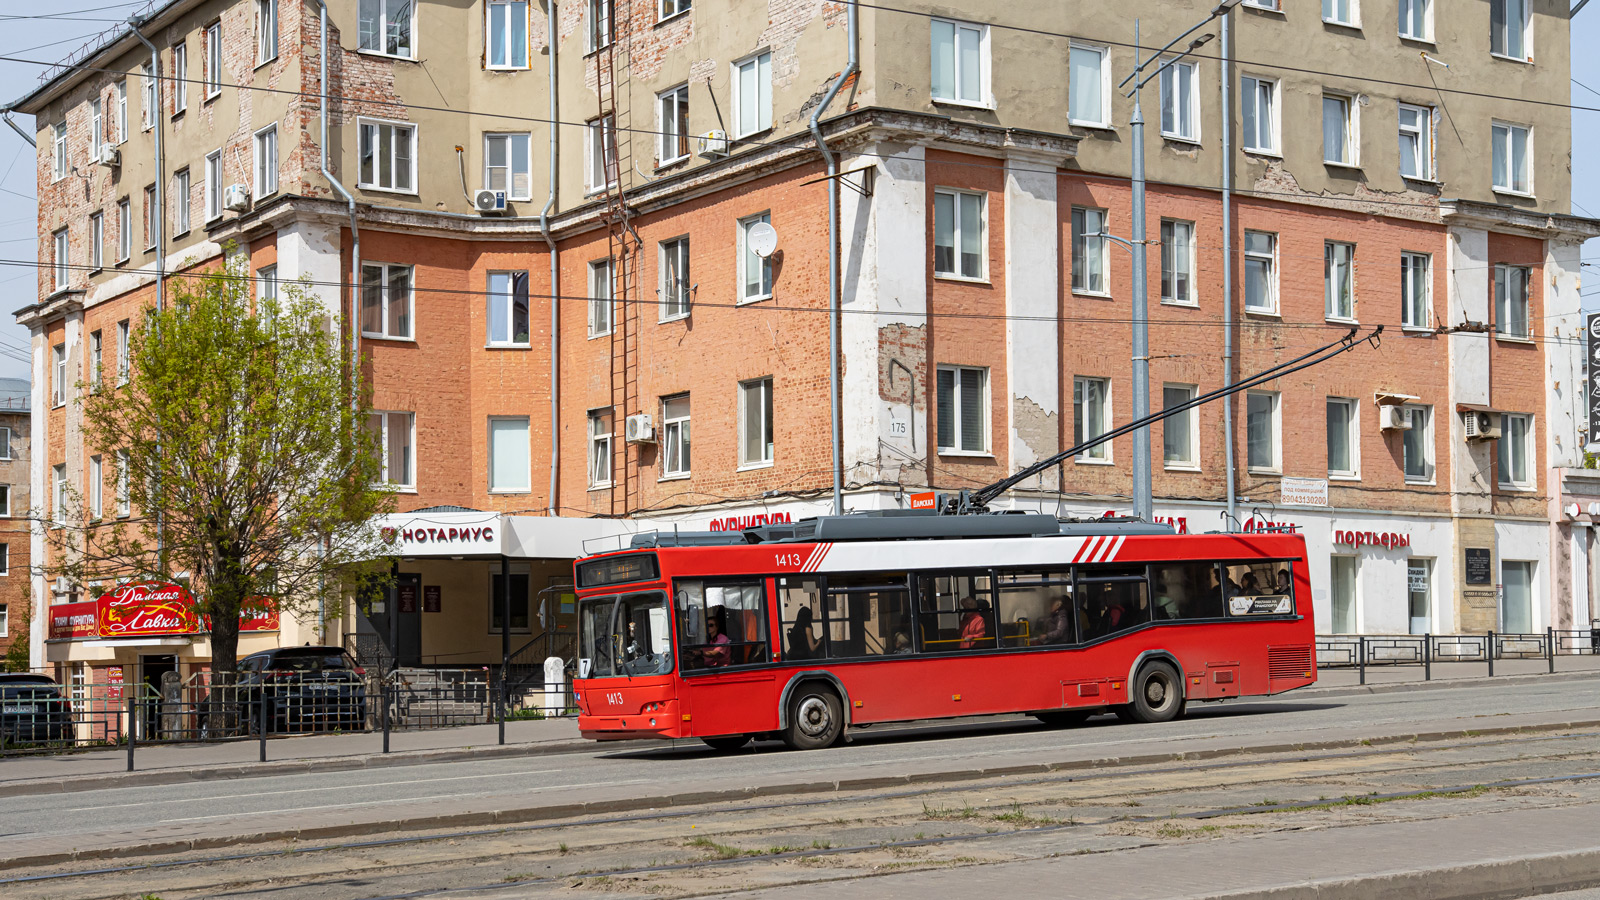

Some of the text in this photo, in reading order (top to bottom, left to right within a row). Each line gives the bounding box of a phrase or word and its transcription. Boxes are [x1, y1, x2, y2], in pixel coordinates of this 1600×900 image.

[891, 422, 906, 434] 175
[402, 527, 494, 544] НОТАРИУС
[1334, 530, 1411, 550] портьеры
[774, 553, 801, 567] 1413
[110, 584, 179, 606] Дамская
[110, 610, 180, 632] Лавка
[582, 660, 588, 675] 7
[606, 692, 624, 706] 1413
